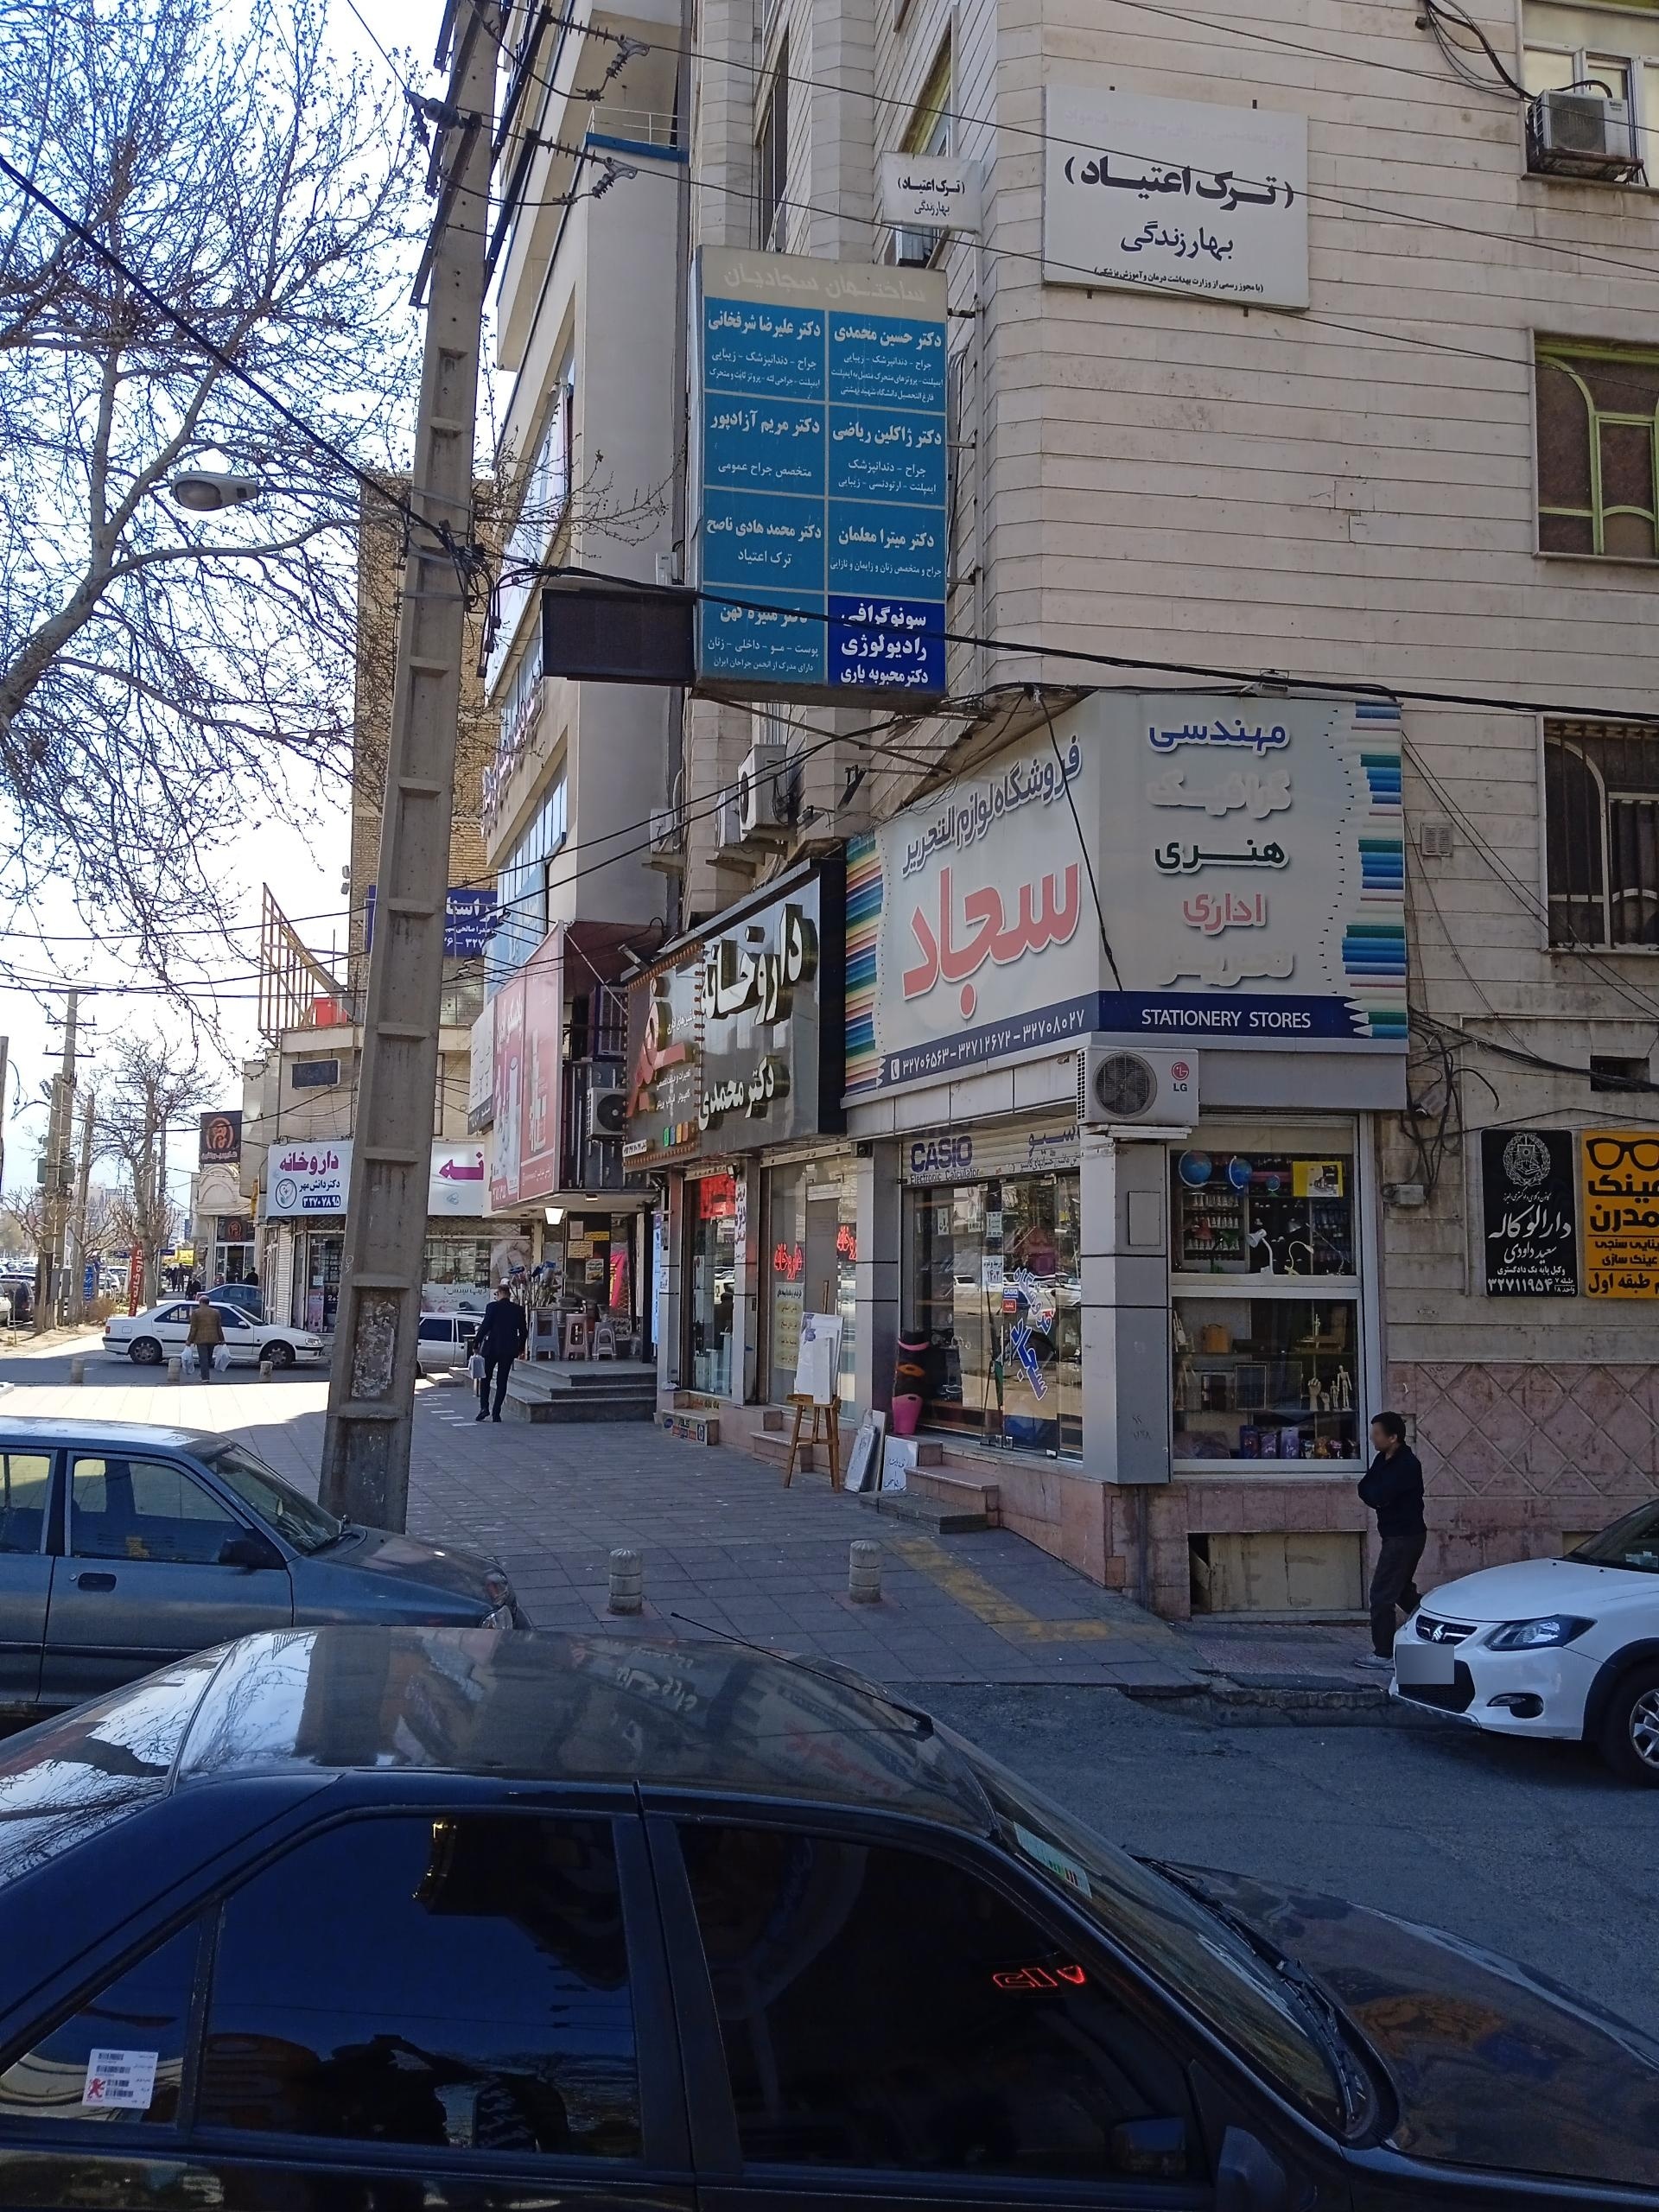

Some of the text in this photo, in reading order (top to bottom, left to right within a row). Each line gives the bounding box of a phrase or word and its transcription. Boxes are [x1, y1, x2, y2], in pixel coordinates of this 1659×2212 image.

[1120, 220, 1234, 261] بهار زندگی
[1148, 274, 1166, 283] درمان
[1167, 276, 1192, 285] بهداشت
[1192, 279, 1211, 288] وزارت
[759, 315, 793, 338] علیرضا
[797, 321, 821, 340] دکتر
[834, 326, 941, 350] دکتر حسین محمدی
[711, 347, 817, 370] جراح دندانپزشک زیبایی
[843, 353, 931, 371] جراح دندانپزشک زیبایی
[710, 409, 820, 436] دکتر مریم آزادپور
[832, 421, 942, 448] دکتر ژاکلین ریاضی
[718, 462, 812, 478] متخصص جراح عمومی
[848, 459, 926, 478] جراح دندانپزشک
[838, 477, 861, 488] زیبایی
[707, 517, 822, 542] دکتر محمد هادی ناصح
[838, 525, 934, 550] دکتر میترا معلمان
[738, 549, 792, 569] ترک اعتیاد
[880, 563, 893, 574] زنان
[894, 564, 919, 575] متخصص
[926, 567, 942, 577] جراح
[708, 637, 819, 657] پوست مو داخلی زنان
[841, 633, 927, 661] رادیولوژی
[714, 657, 728, 666] ایران
[729, 658, 752, 669] جراحان
[753, 660, 771, 670] انجمن
[779, 662, 797, 671] مدرک
[798, 663, 813, 673] دارای
[840, 664, 928, 687] دکتر محبوبه یاری
[1149, 719, 1286, 752] مهندسی
[901, 734, 1082, 876] فروشگاه لوازم التحریر
[1154, 839, 1285, 869] هنری
[1183, 893, 1262, 931] اداری
[902, 863, 1081, 1019] سجاد
[701, 904, 810, 1026] داروخانه
[1141, 1009, 1311, 1028] STATIONERY STORES
[698, 1058, 776, 1131] دکتر محمدی
[1173, 1083, 1188, 1092] LG
[279, 1150, 339, 1175] داروخانه
[911, 1135, 973, 1173] CASIO
[326, 1179, 340, 1192] دکتر
[911, 1168, 980, 1184] Electronic Calculator
[1595, 1239, 1628, 1251] سنجی
[1535, 1246, 1557, 1264] سعید
[1602, 1254, 1658, 1267] عینک سازی
[1497, 1266, 1527, 1275] دادگستری
[1539, 1266, 1549, 1275] پایه
[1550, 1266, 1566, 1275] وکیل
[1487, 1278, 1554, 1292] ۳۲۷۱۱۹۵۴
[1588, 1272, 1614, 1294] اول
[1618, 1272, 1650, 1294] طبقه
